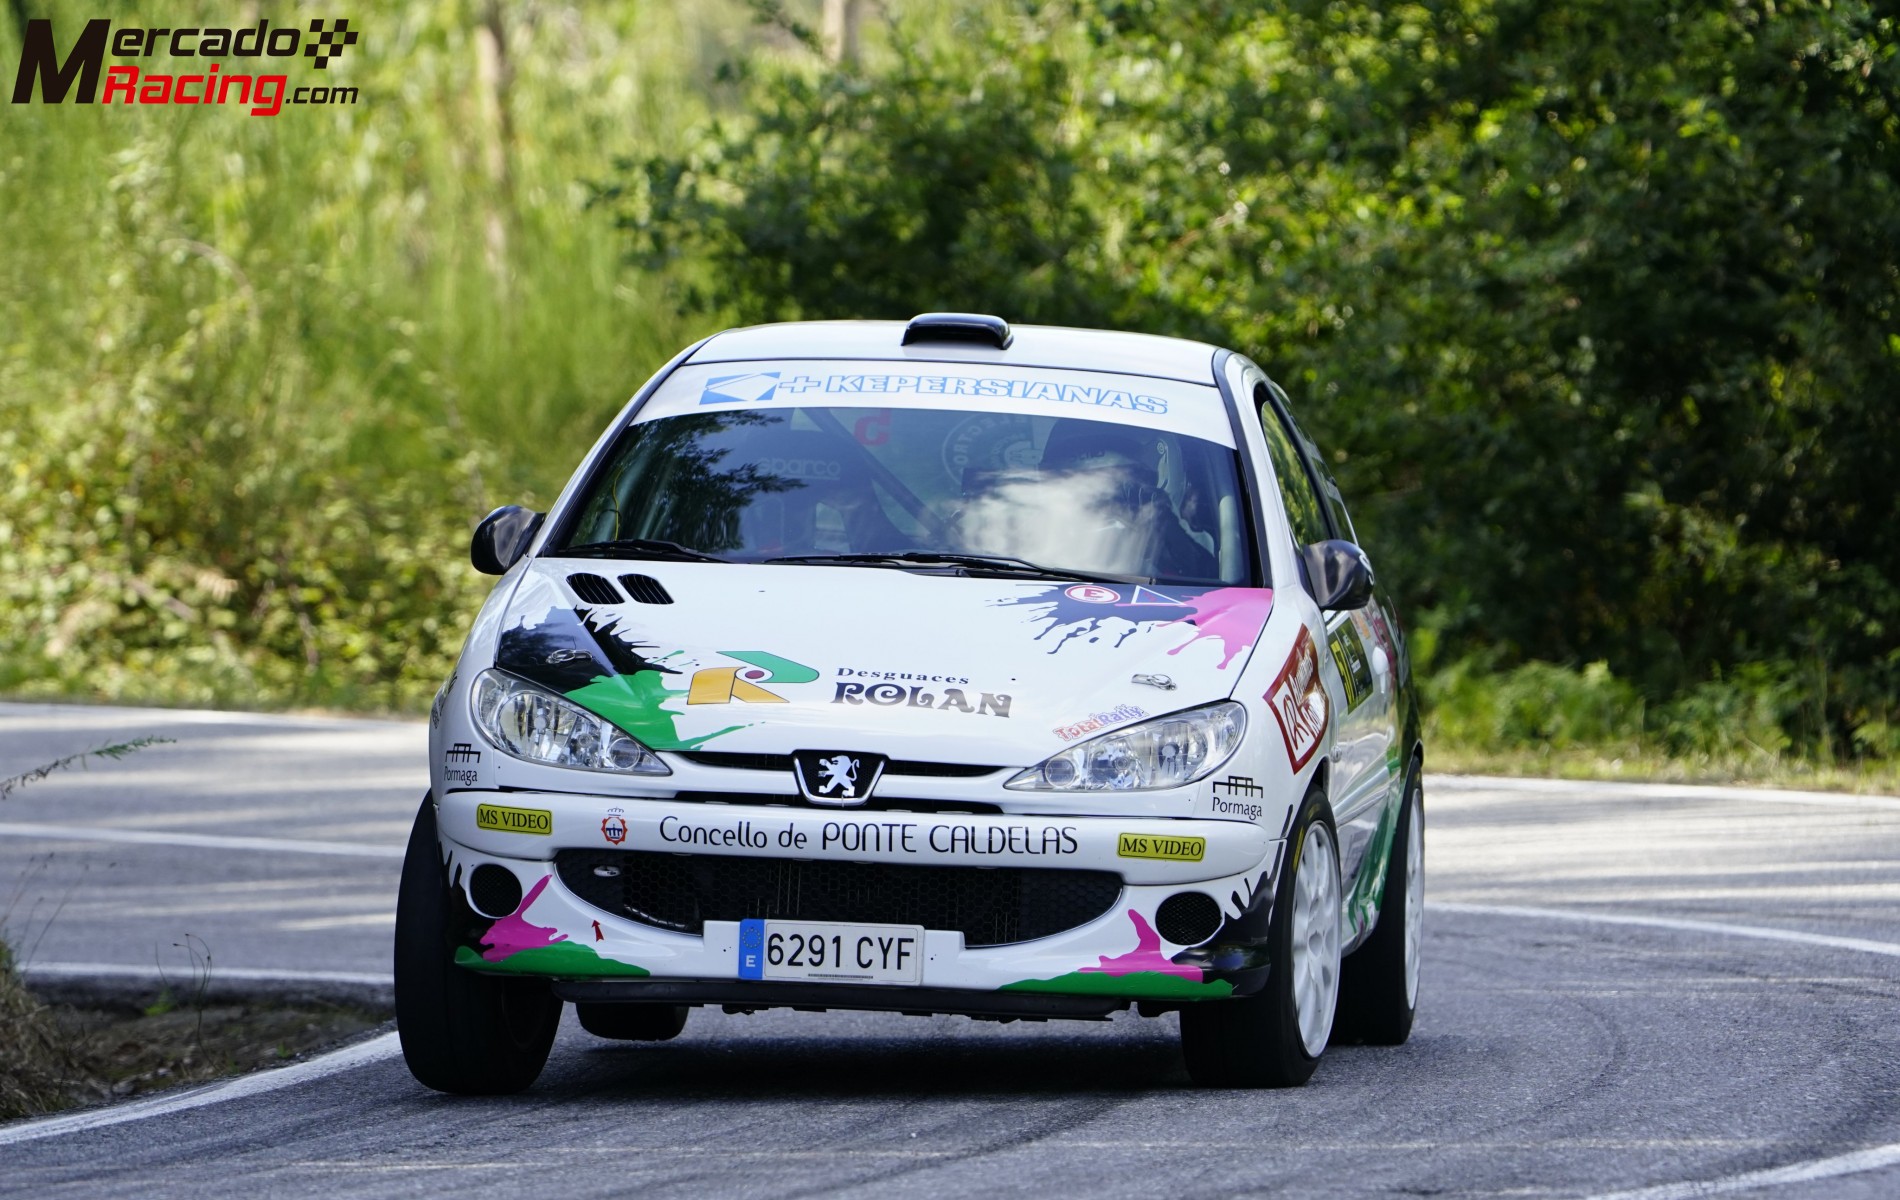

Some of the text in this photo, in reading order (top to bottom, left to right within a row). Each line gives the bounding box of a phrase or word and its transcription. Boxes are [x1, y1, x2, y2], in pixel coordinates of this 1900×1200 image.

[757, 457, 841, 477] sparco
[1083, 588, 1105, 599] E
[836, 667, 969, 685] Desguaces
[830, 681, 1012, 718] ROLAN
[444, 765, 478, 787] Pormaga
[479, 808, 549, 830] MS VIDEO
[1212, 796, 1263, 821] Pormaga
[659, 815, 1078, 855] Concello de PONTE CALDELAS
[1121, 837, 1203, 857] MS VIDEO
[745, 954, 757, 968] E
[767, 932, 915, 971] 6291 CYF
